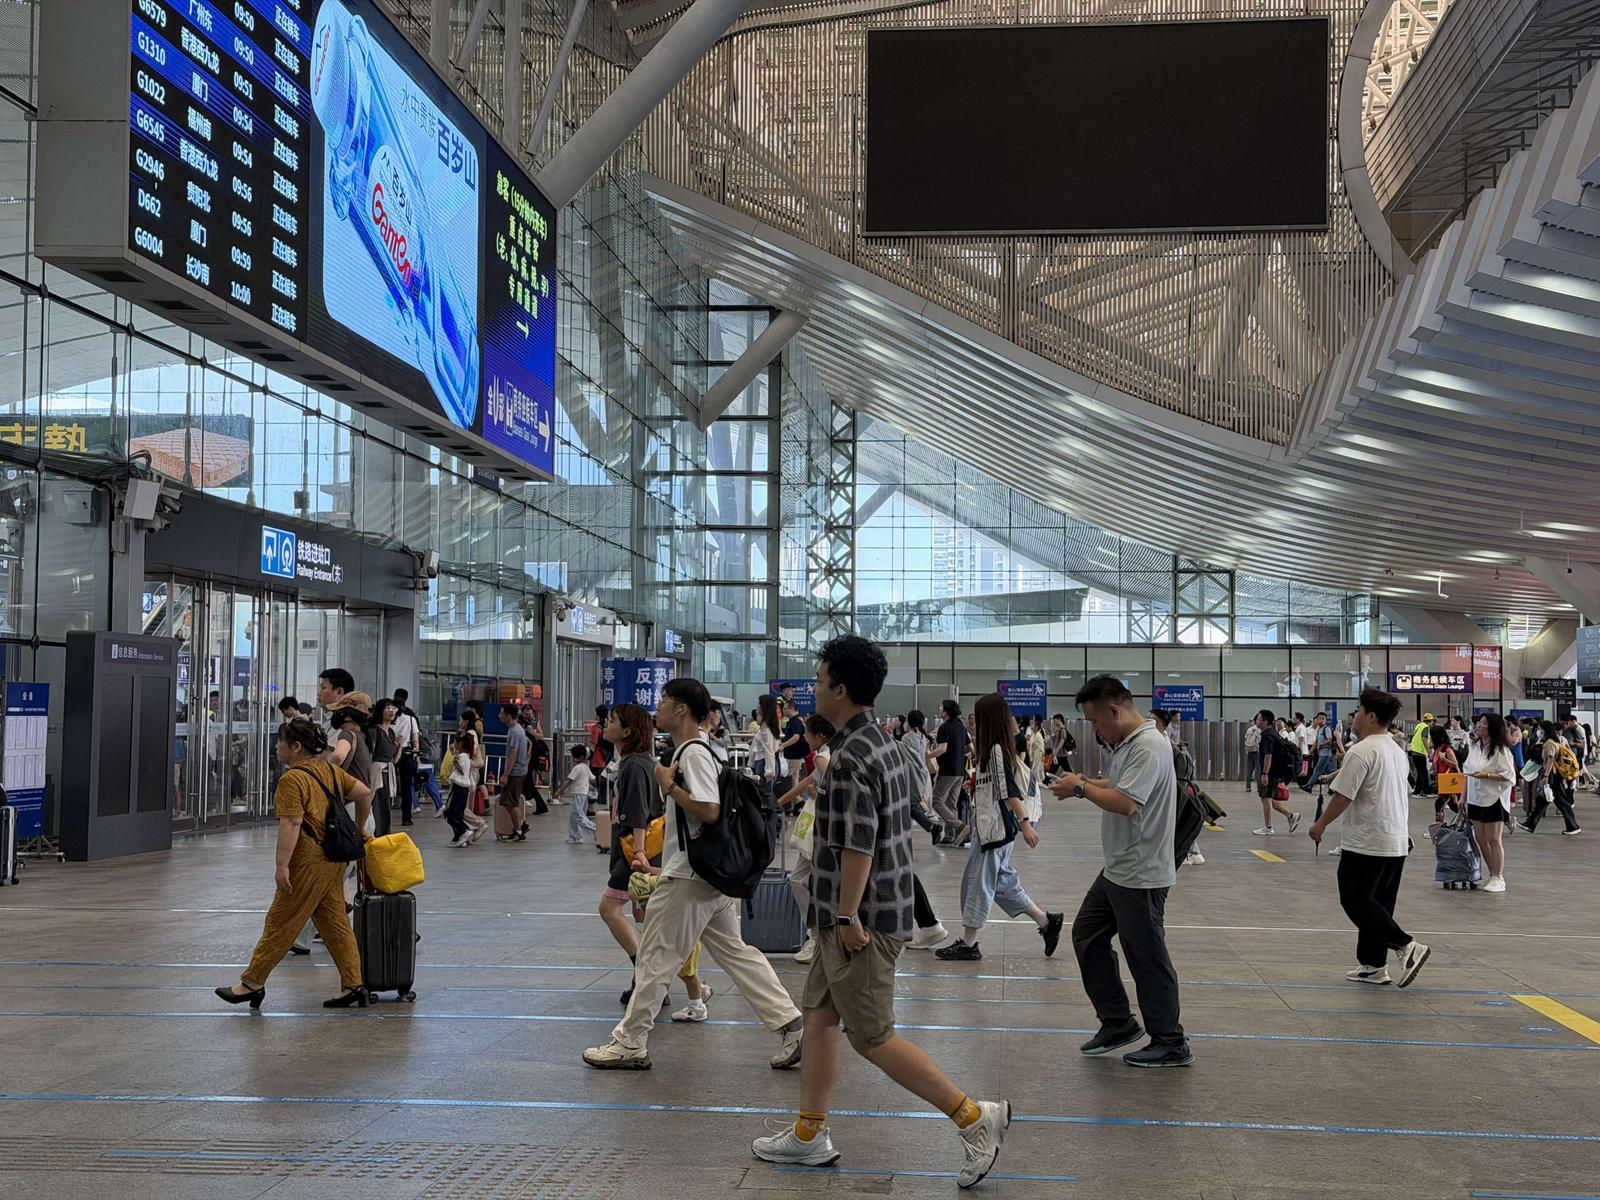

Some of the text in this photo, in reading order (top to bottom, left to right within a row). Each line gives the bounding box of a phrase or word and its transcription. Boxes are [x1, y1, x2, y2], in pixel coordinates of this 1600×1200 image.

[138, 0, 300, 140] G6579 香港西九龙 09:51 正在候车
[188, 0, 300, 106] 广州东 09:50 正在候车
[234, 2, 300, 75] 09:50 正在候车
[274, 5, 301, 42] 正在候车
[136, 70, 299, 204] G1022 福州南 09:54 正在候车
[137, 31, 299, 172] G1310 厦门 09:54 正在候车
[401, 86, 476, 192] 水中贵族 百岁山
[135, 148, 298, 269] G2946 贵阳北 09:56 正在候车
[136, 109, 298, 236] G6545 香港西九龙 09:56 正在候车
[134, 226, 297, 333] G6004 长沙南 10:00 正在候车
[137, 188, 297, 301] D662 厦门 09:59 正在候车
[508, 273, 538, 319] 专用通道
[297, 539, 331, 566] 铁路进站口
[1413, 675, 1465, 685] 商务座候车区
